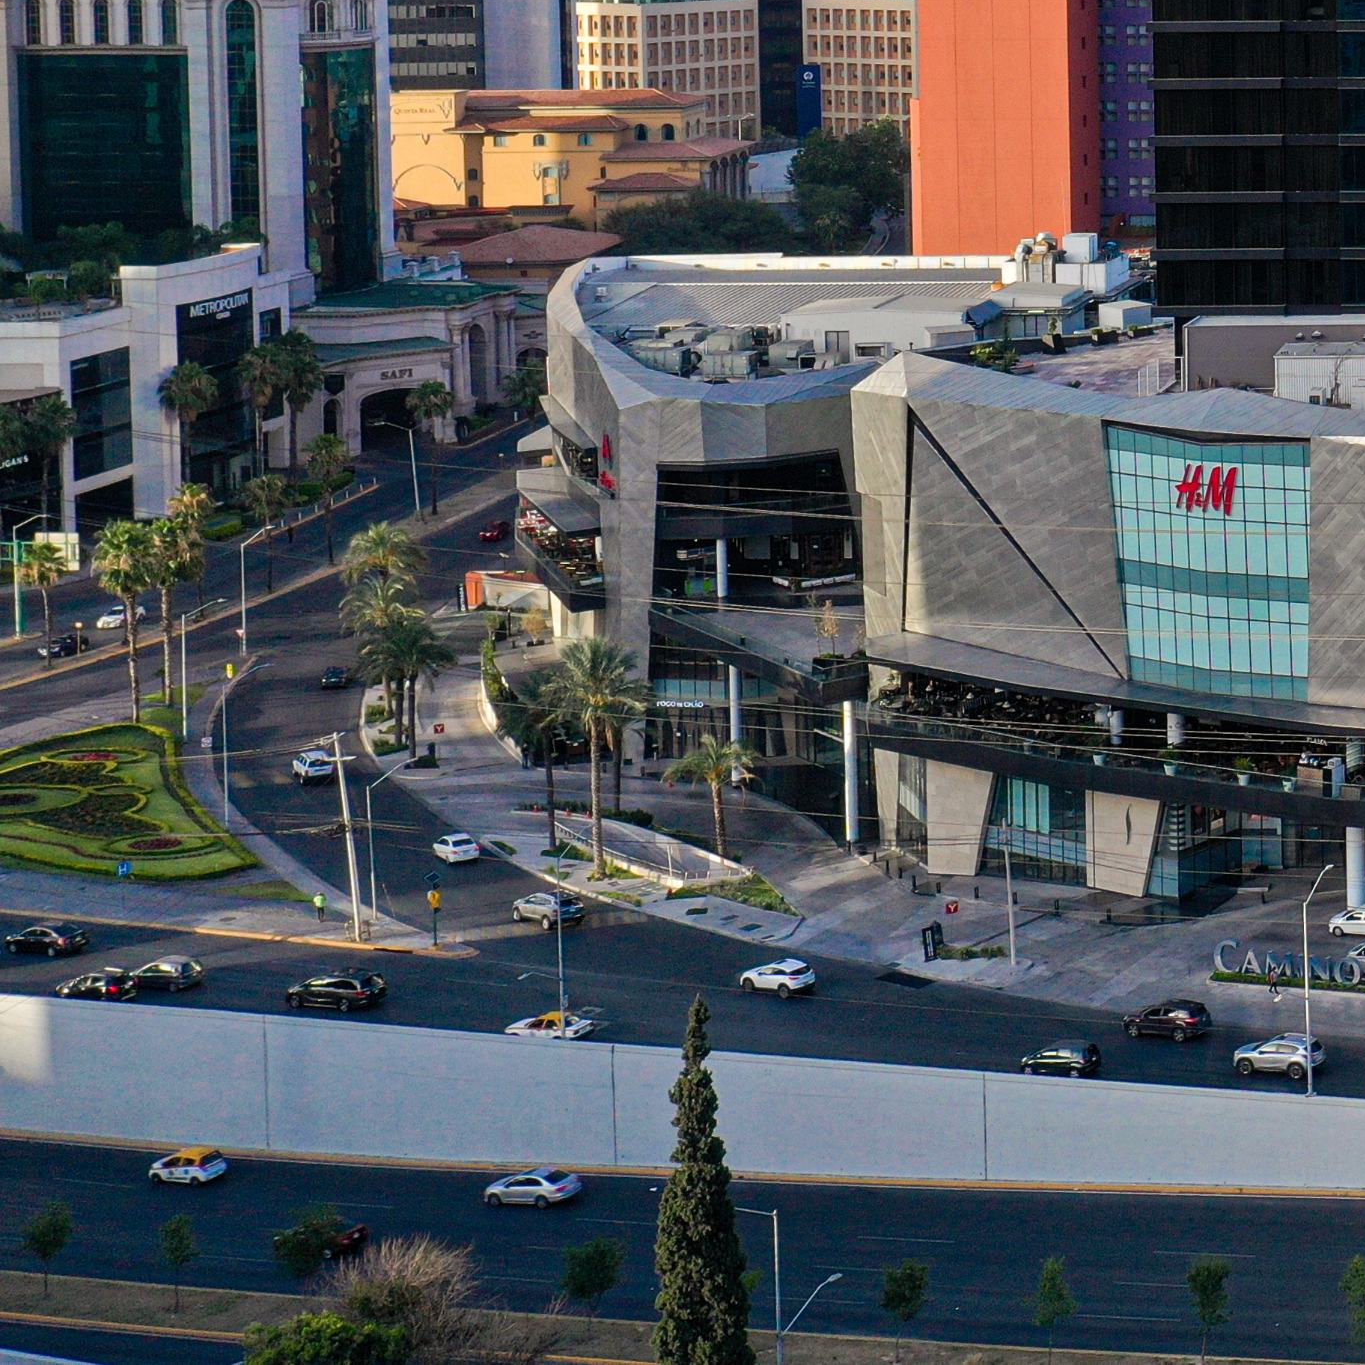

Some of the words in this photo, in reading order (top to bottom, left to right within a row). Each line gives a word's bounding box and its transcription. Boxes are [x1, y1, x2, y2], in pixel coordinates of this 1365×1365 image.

[190, 292, 249, 318] METROPOLITAN
[380, 368, 413, 380] SAFI
[1175, 463, 1238, 516] H&M
